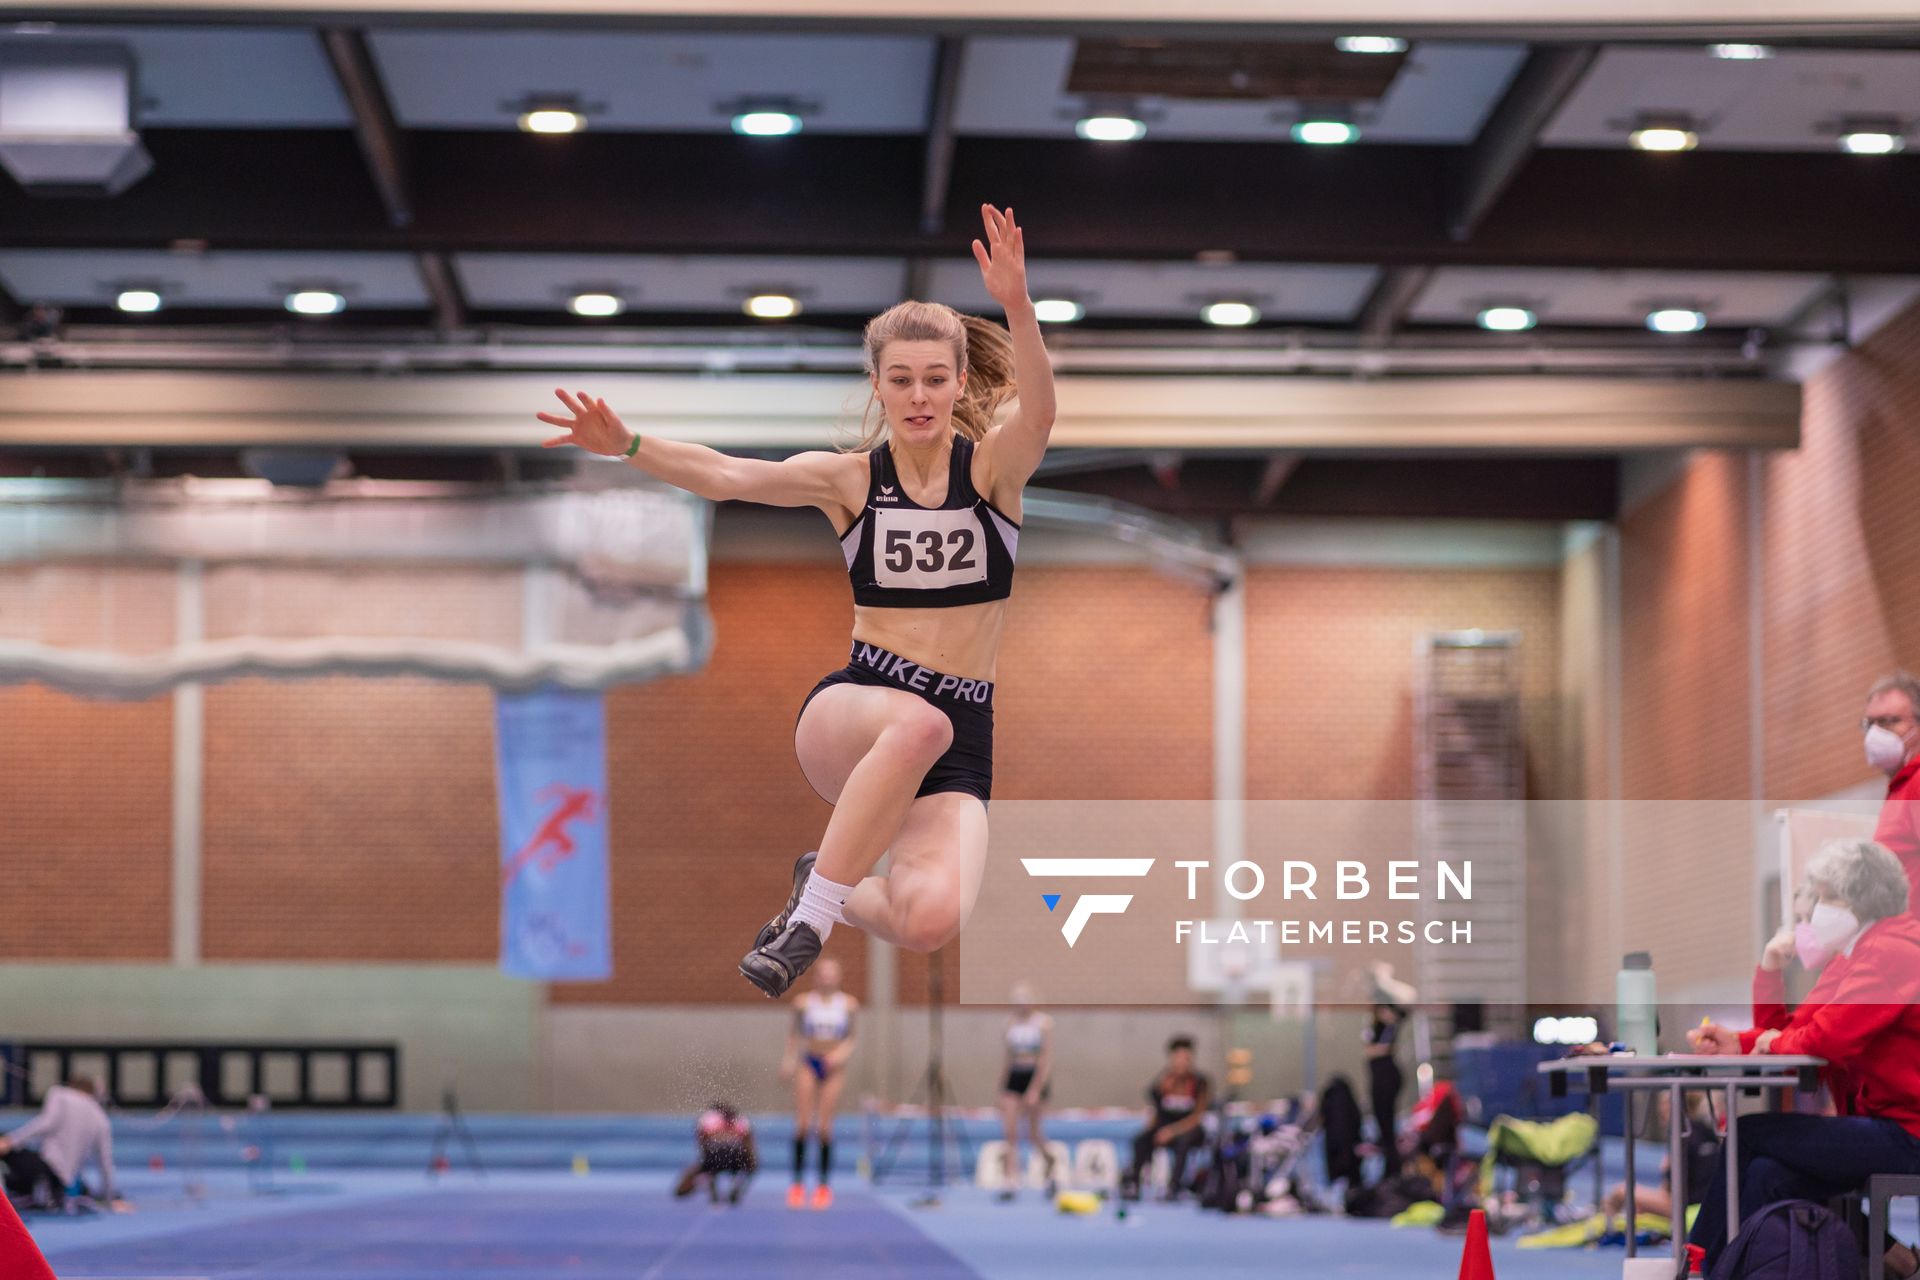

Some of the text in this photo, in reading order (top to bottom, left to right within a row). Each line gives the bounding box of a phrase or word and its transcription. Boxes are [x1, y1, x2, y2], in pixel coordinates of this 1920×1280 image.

[884, 529, 976, 573] 532
[858, 643, 935, 691] NIKE
[934, 675, 989, 704] PRO
